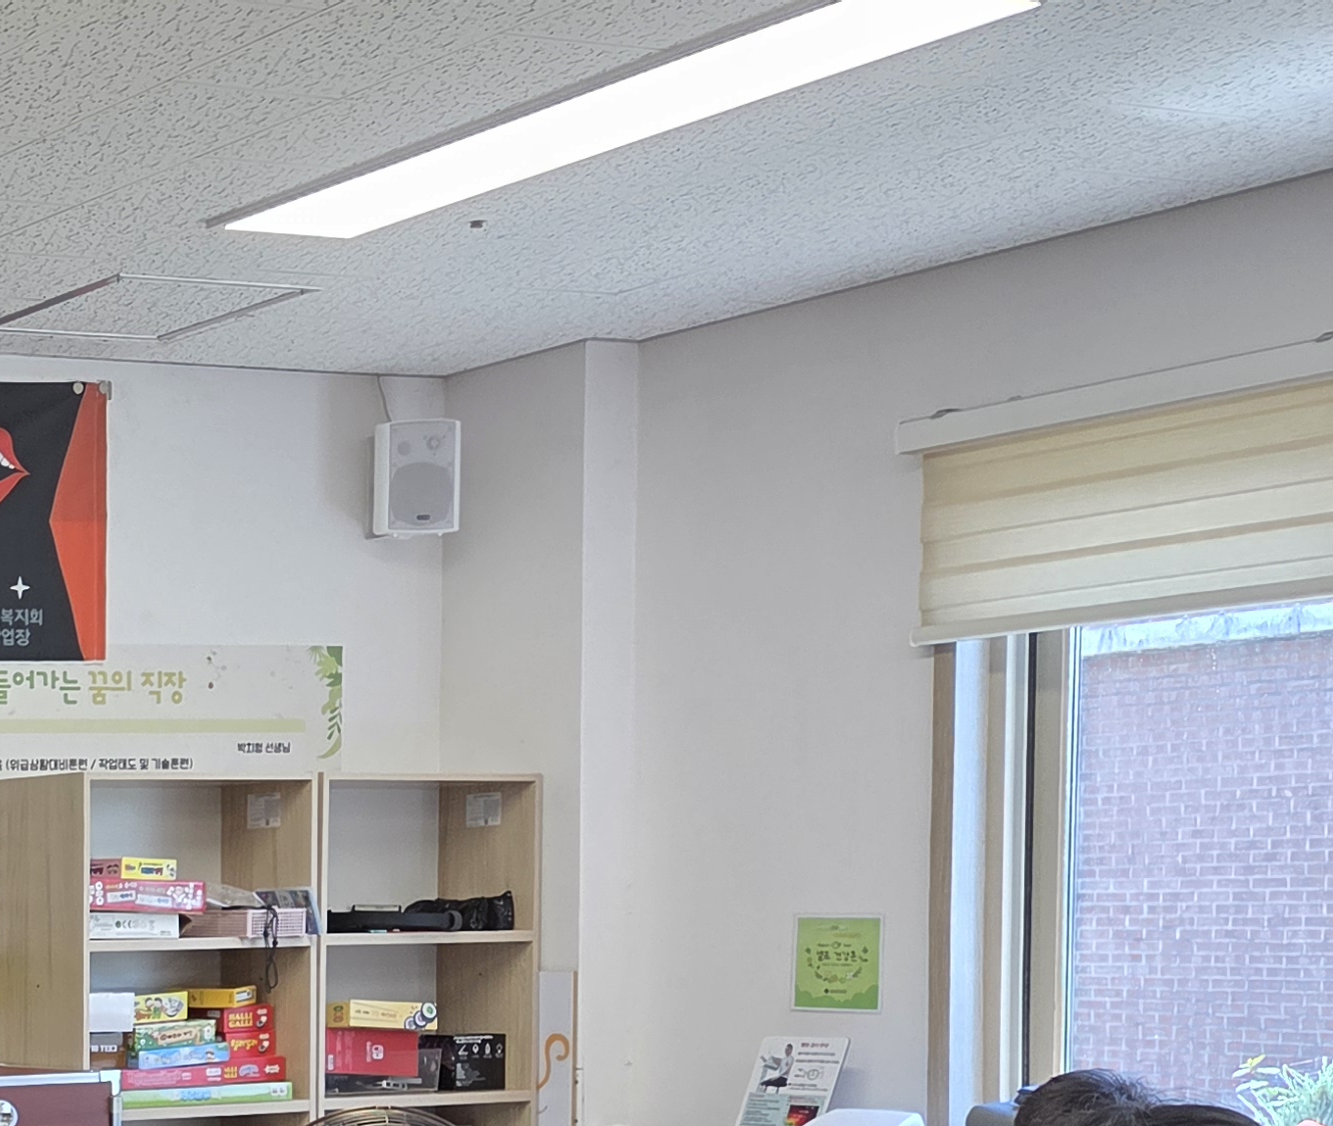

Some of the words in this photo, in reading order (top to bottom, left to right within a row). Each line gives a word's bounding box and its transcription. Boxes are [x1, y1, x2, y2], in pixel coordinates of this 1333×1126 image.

[87, 669, 132, 705] 꿈의
[140, 670, 188, 705] 직장
[139, 757, 149, 771] 및
